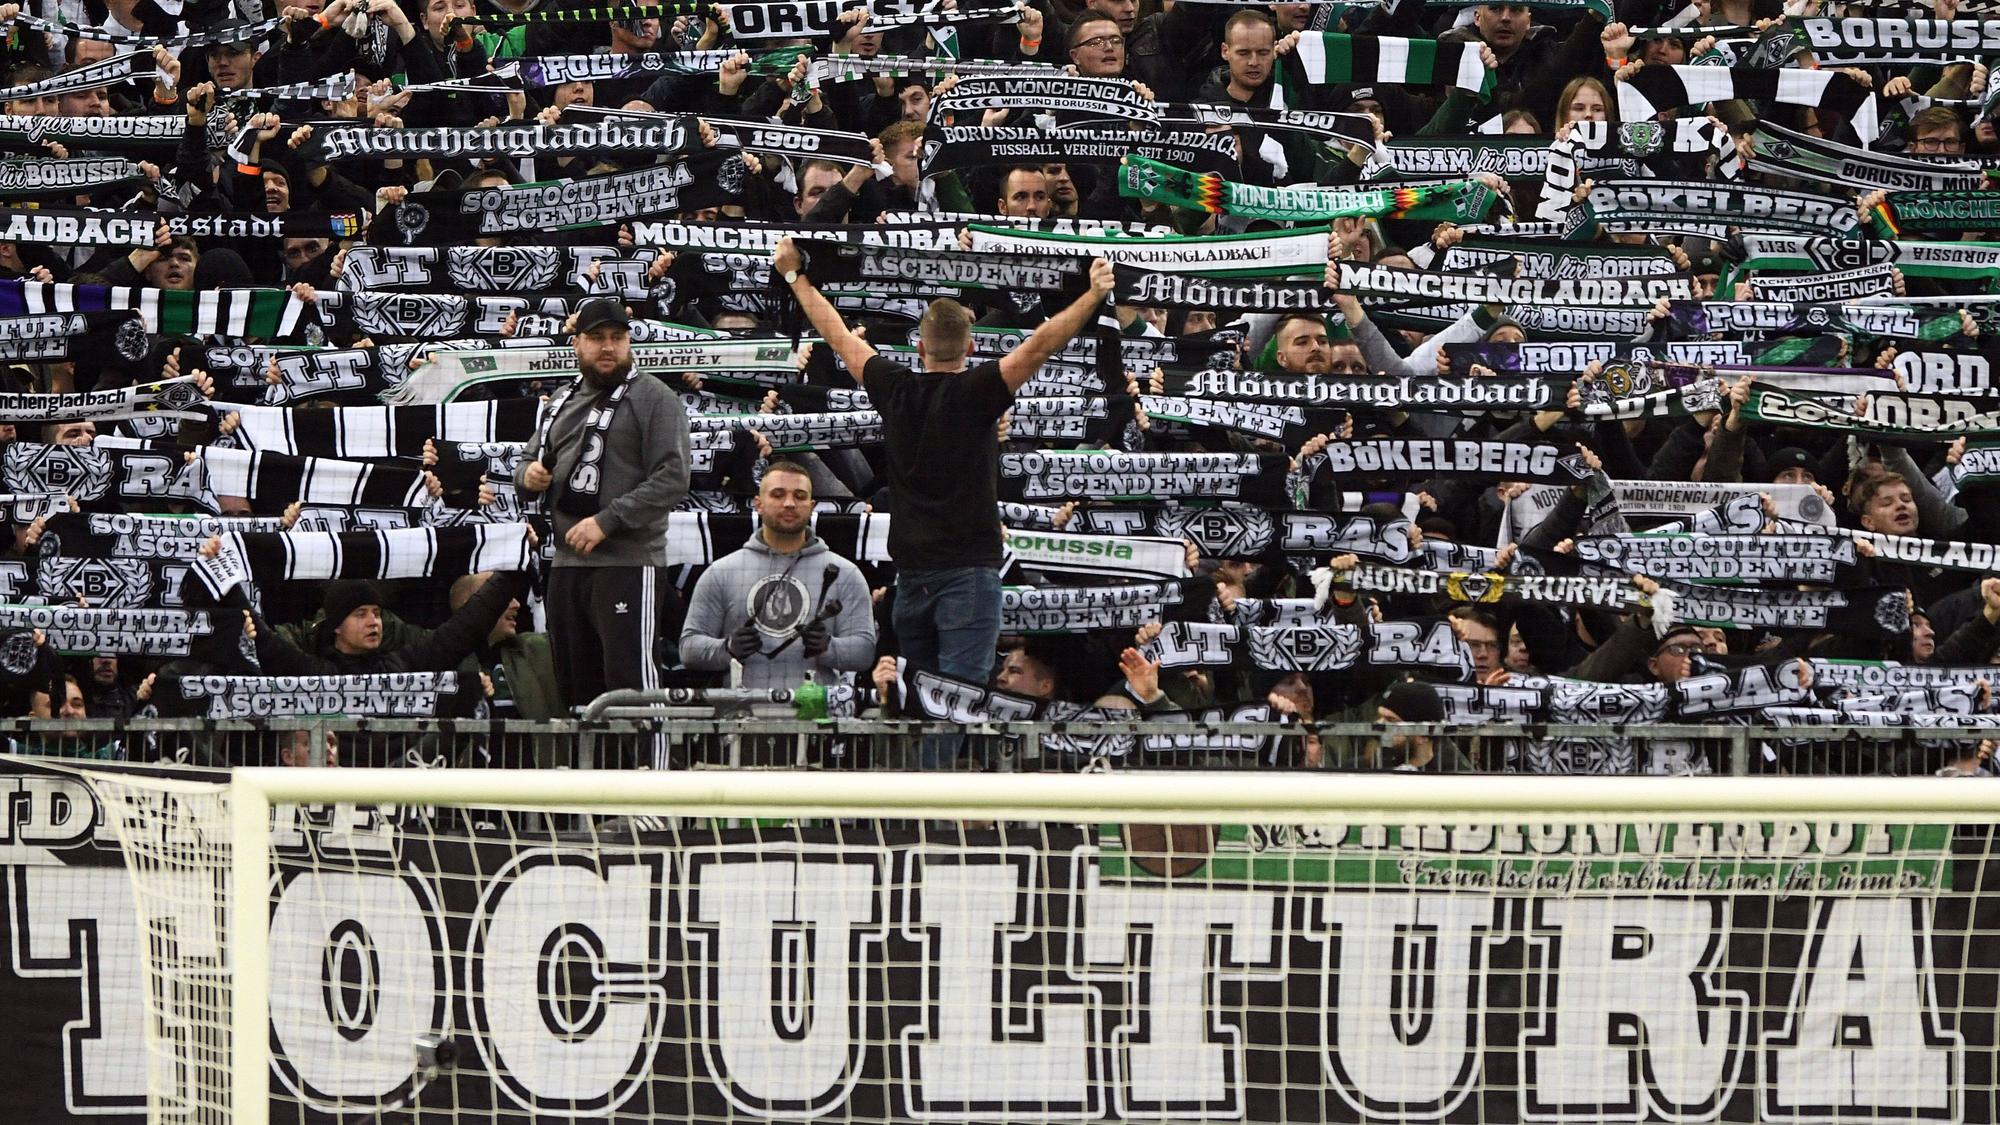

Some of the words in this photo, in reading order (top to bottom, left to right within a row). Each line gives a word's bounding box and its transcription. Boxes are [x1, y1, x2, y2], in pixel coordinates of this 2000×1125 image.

[942, 80, 1000, 99] USSIA
[1005, 78, 1157, 111] MÖNCHENGLAD
[1001, 96, 1024, 106] WIR
[1026, 98, 1051, 106] SIND
[1054, 99, 1108, 112] BORUSSIA
[71, 116, 186, 136] BORUSSIA
[1277, 110, 1335, 130] 1900
[323, 122, 686, 161] Mönchengladbach
[752, 130, 820, 150] 1900
[942, 127, 1040, 145] BORUSSIA
[992, 144, 1060, 156] FUSSBALL.
[1064, 143, 1129, 157] VERRÜCKT
[1137, 146, 1163, 159] SEIT
[1166, 150, 1195, 163] 1900
[462, 163, 693, 213] SOTTOCULTURA
[1843, 162, 1932, 190] BORUSSIA
[481, 187, 678, 233] ASCENDENTE
[1587, 186, 1859, 231] BÖKELBERG
[0, 215, 155, 244] ADBACH
[170, 213, 285, 238] sstadt
[861, 254, 1063, 290] ASCENDENTE
[1553, 256, 1588, 279] für
[1588, 257, 1676, 278] BORUSS
[1130, 272, 1338, 310] Mönchen
[1340, 263, 1692, 307] MÖNCHENGLADBACH
[1541, 306, 1651, 334] BORUSSI
[1893, 352, 1990, 394] ORD
[1186, 368, 1551, 407] Mönchengladbach
[1141, 397, 1286, 437] NDENTE
[1001, 452, 1262, 479] SOTTOCULTURA
[1327, 440, 1559, 476] BÖKELBERG
[1024, 473, 1241, 498] ASCENDENTE
[1577, 535, 1857, 566] SOTTOCULTURA
[1001, 583, 1183, 613] OCULTURA
[1352, 567, 1440, 594] NORD
[1517, 575, 1630, 608] KURVE
[1001, 604, 1163, 630] ENDENTE
[1672, 600, 1829, 628] ENDENTE
[50, 630, 192, 656] NDENTE
[181, 672, 458, 698] SOTTOCULTURA
[208, 691, 438, 719] ASCENDENTE
